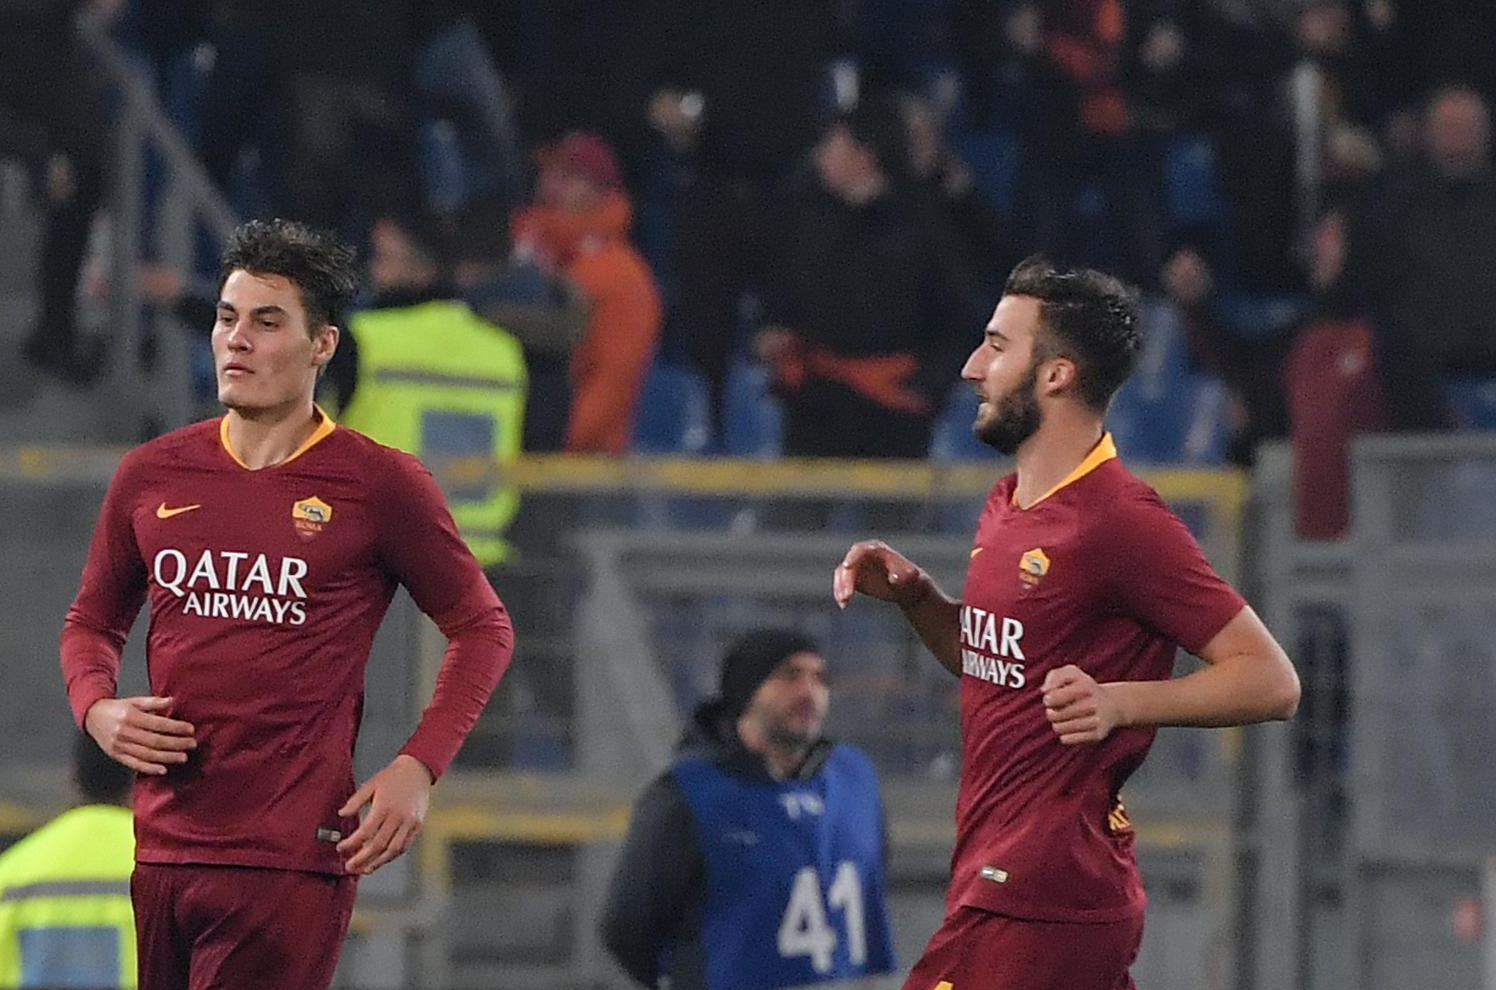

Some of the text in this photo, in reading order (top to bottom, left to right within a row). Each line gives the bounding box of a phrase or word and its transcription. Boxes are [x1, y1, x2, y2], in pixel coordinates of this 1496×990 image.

[154, 548, 308, 599] QATAR
[182, 591, 307, 626] AIRWAYS
[959, 604, 1026, 661] ATAR
[777, 864, 868, 974] 41
